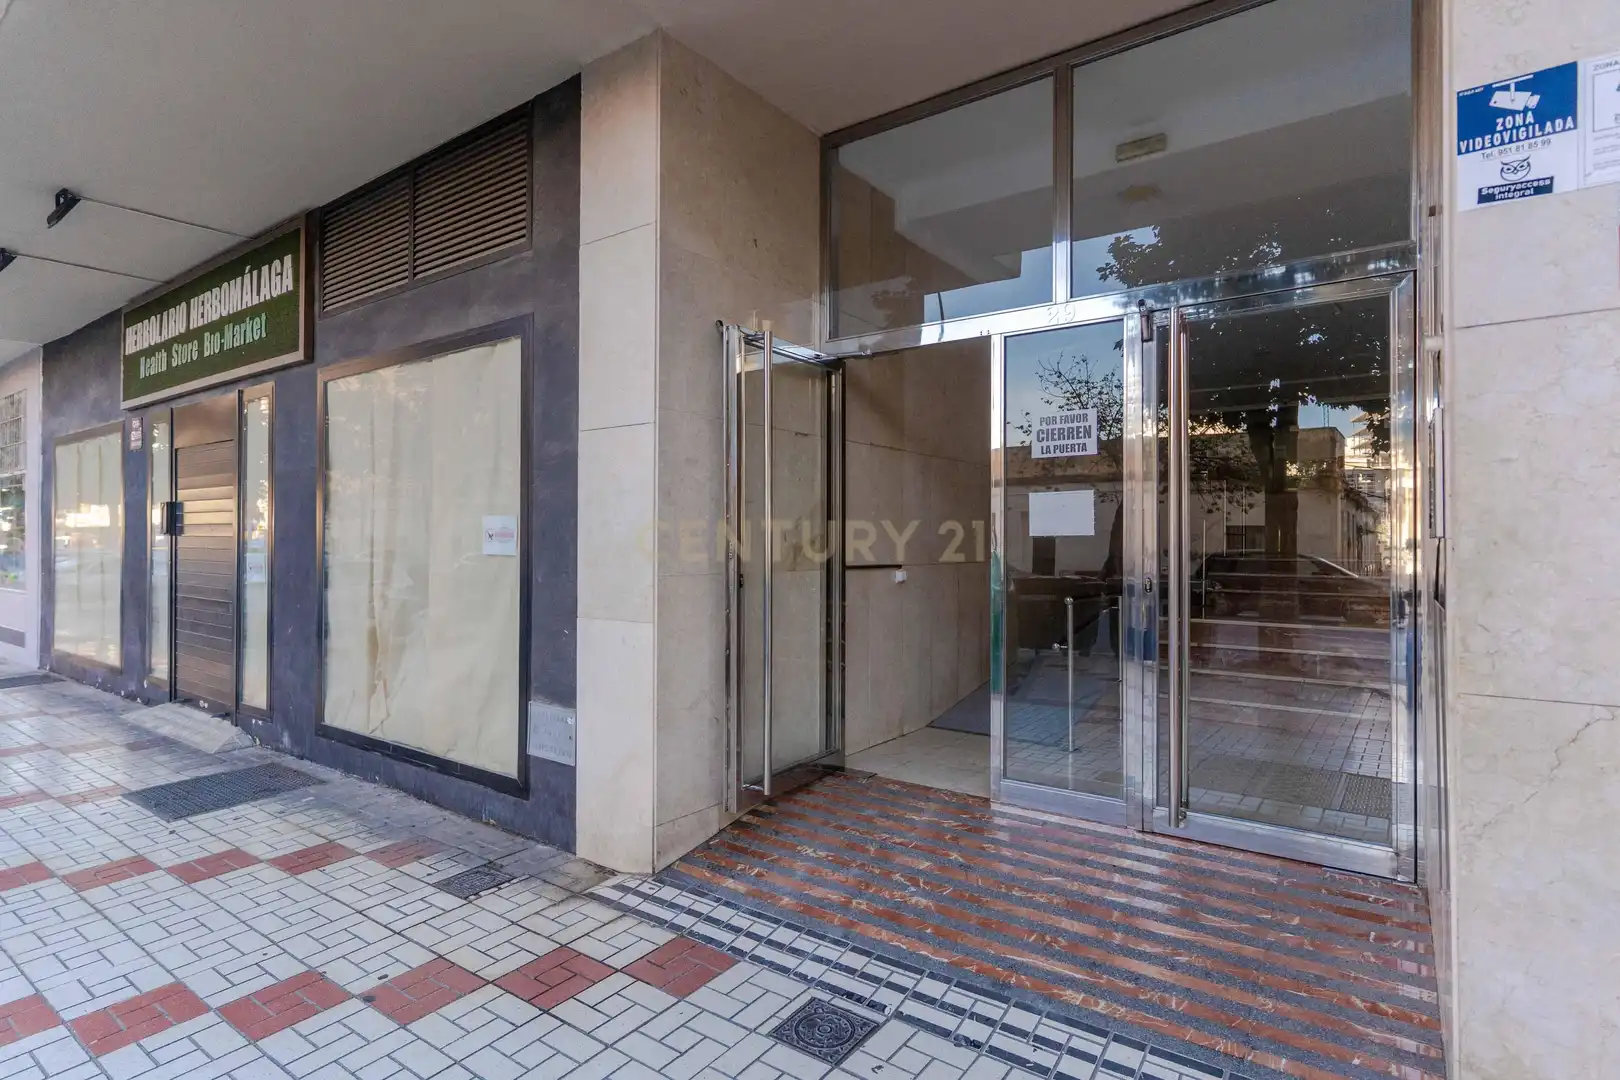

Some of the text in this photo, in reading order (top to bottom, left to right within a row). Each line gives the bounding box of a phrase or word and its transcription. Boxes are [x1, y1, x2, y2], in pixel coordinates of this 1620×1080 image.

[1496, 111, 1534, 131] ZONA
[1460, 116, 1574, 153] VIDEOVIGILADA
[1498, 147, 1513, 156] 951
[1515, 144, 1525, 153] 81
[1540, 138, 1551, 146] 99
[1481, 179, 1551, 195] Seguryaccess
[125, 254, 293, 355] HERBOLARIO HERBOMÁLAGA
[1047, 304, 1076, 324] 29
[140, 312, 267, 379] Health Store Bio-Market
[1039, 412, 1089, 427] POR FAVOR
[1036, 424, 1092, 443] CIERREN
[1040, 443, 1088, 455] LA PUERTA
